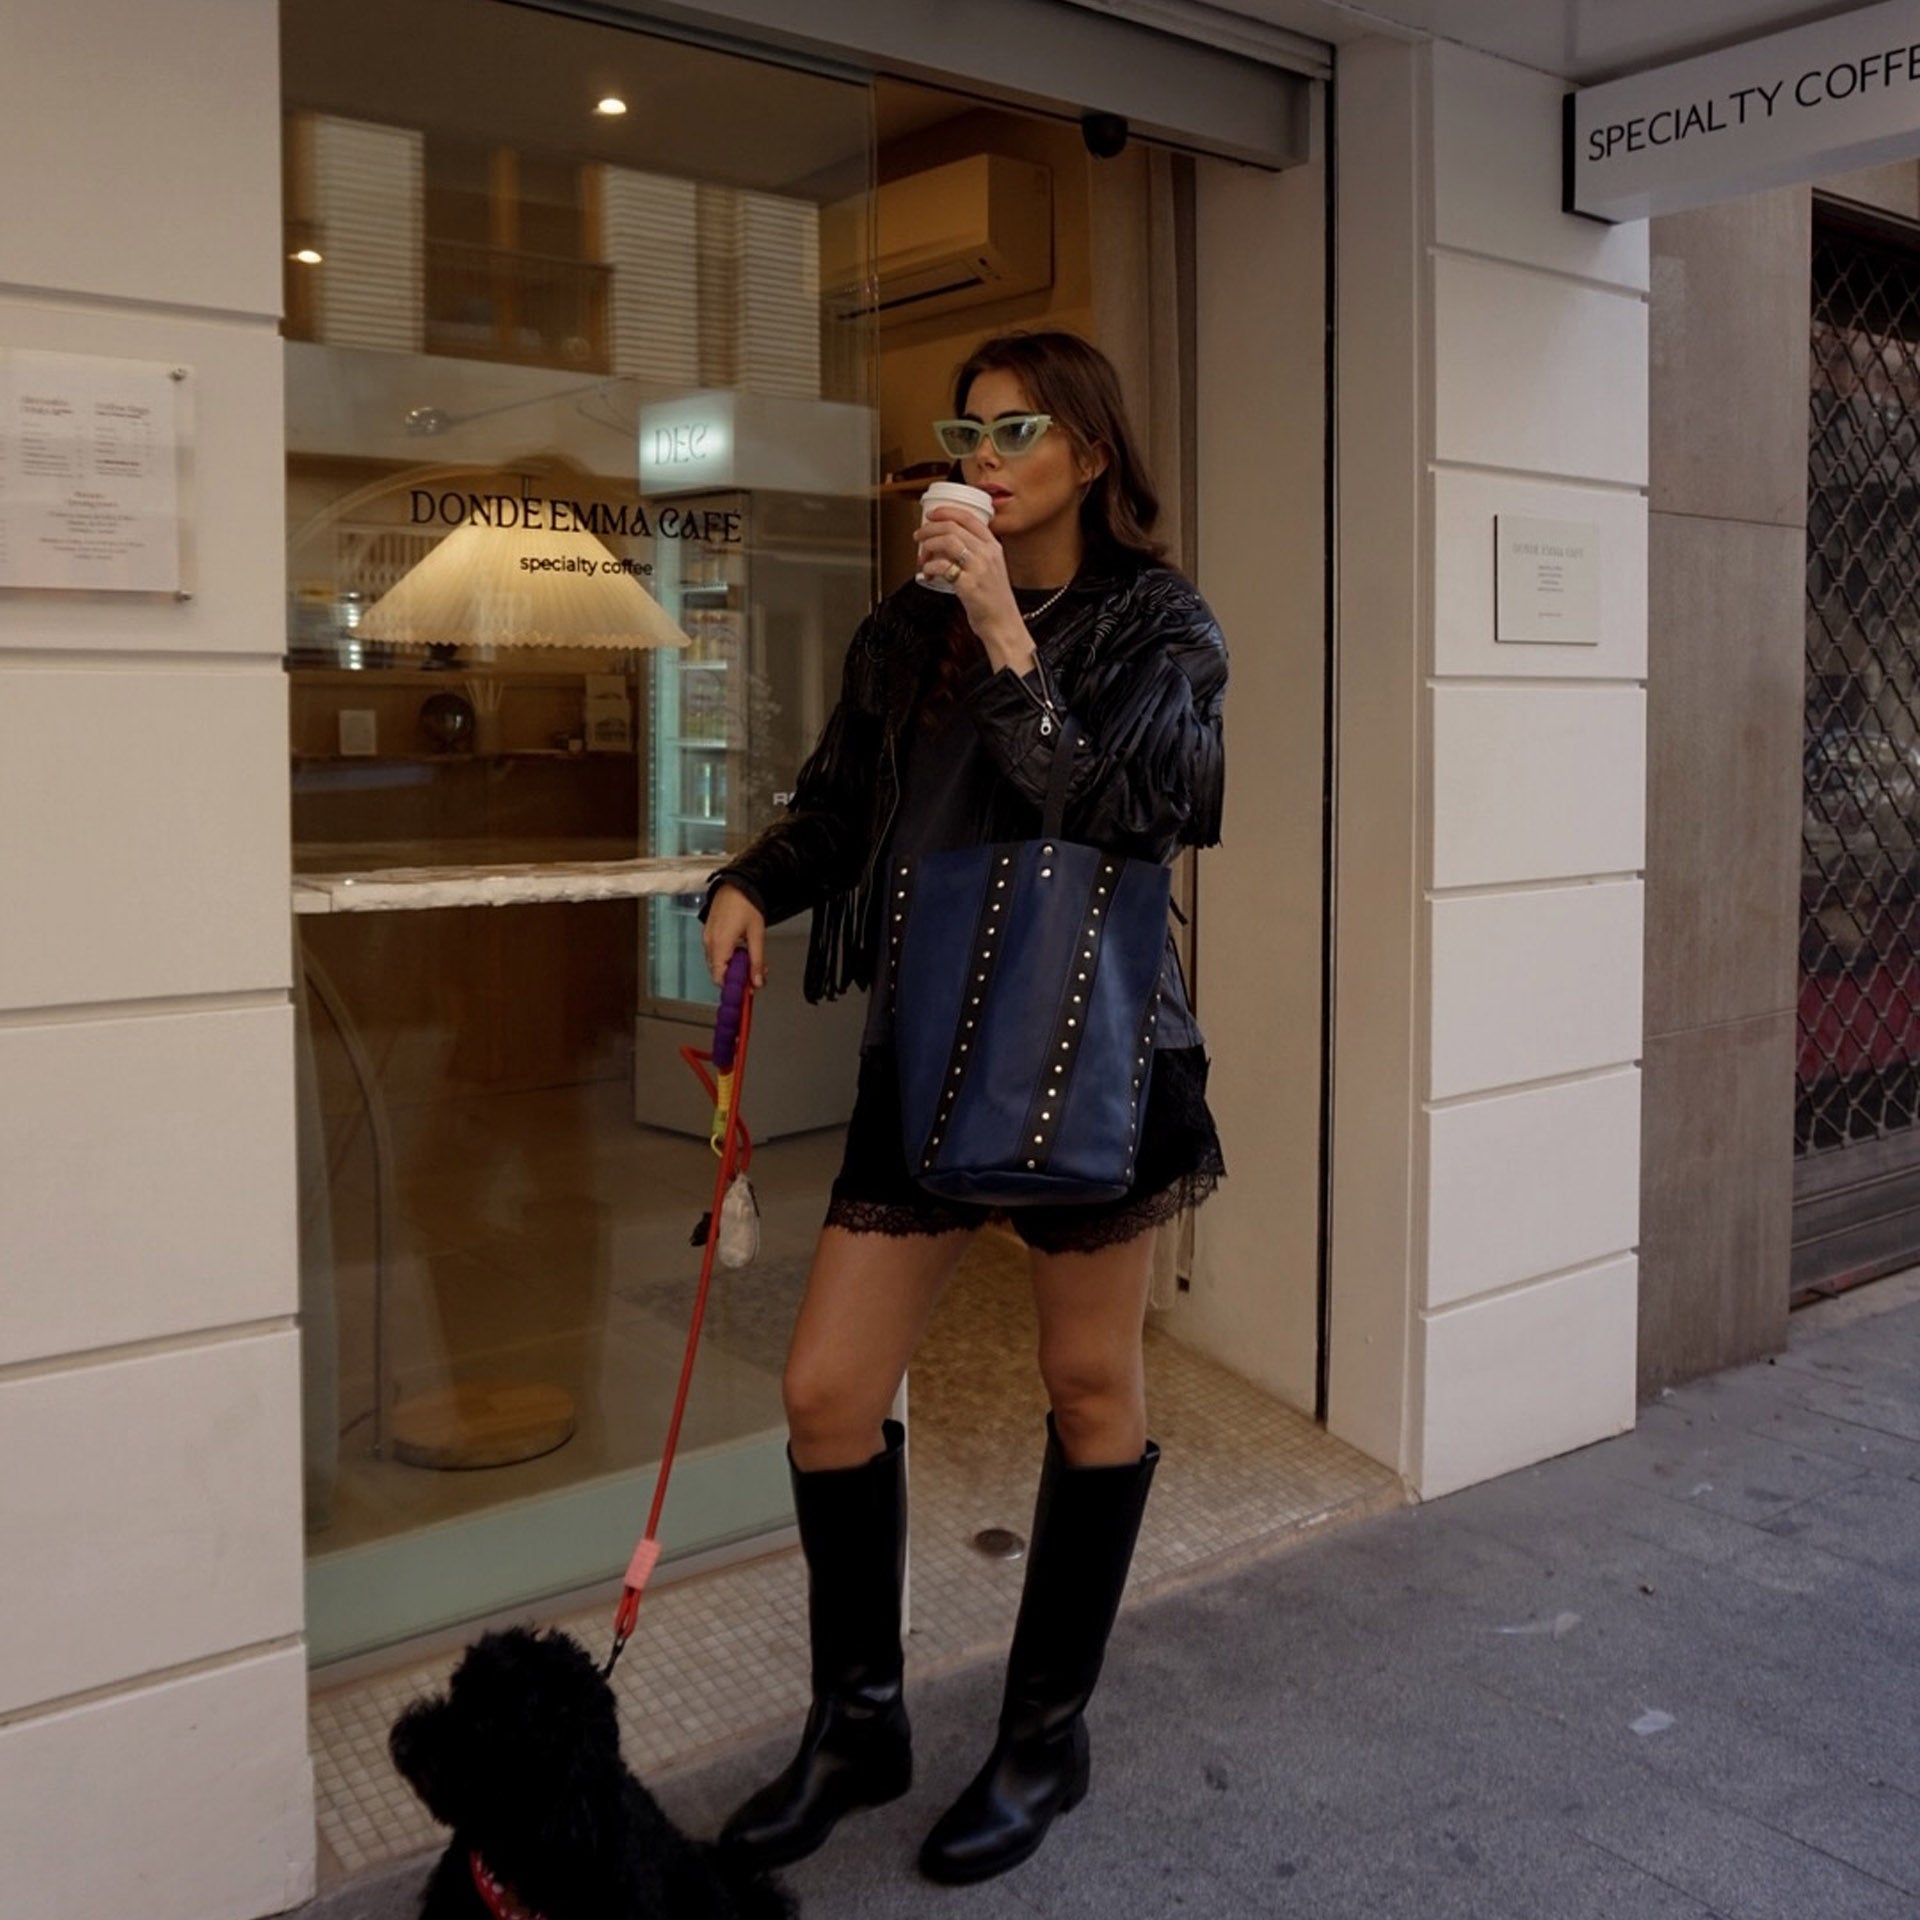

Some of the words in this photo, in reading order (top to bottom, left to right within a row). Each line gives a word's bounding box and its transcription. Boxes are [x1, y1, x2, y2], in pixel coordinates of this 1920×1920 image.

[1588, 81, 1784, 162] SPECIALTY
[410, 490, 543, 529] DONDE
[550, 500, 652, 537] EMMA
[520, 555, 597, 577] specialty
[602, 558, 653, 576] coffee
